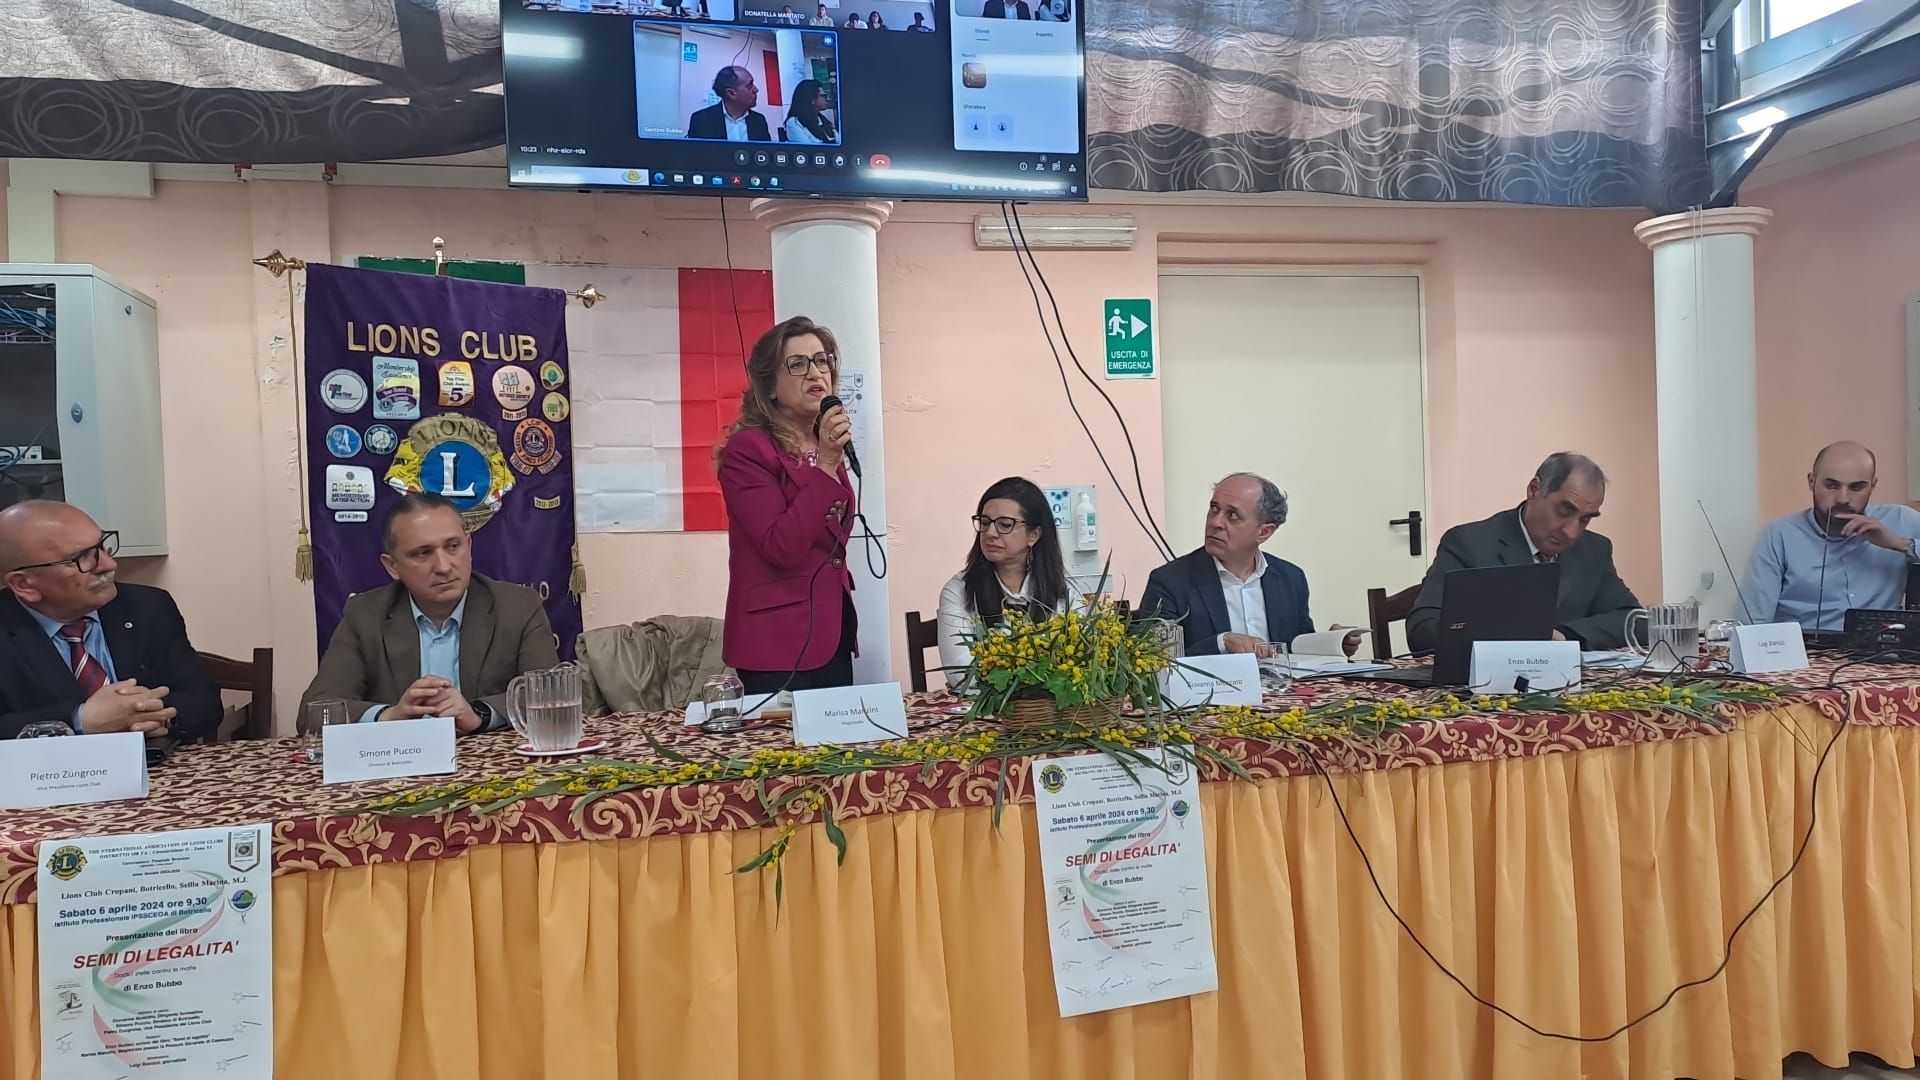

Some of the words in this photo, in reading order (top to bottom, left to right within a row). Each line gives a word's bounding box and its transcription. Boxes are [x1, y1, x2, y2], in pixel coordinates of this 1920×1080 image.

[346, 321, 440, 358] LIONS
[459, 329, 538, 362] CLUB
[1110, 350, 1138, 359] USCITA
[1140, 350, 1149, 358] DI
[376, 362, 417, 372] Membership
[1108, 361, 1152, 370] EMERGENZA
[450, 388, 464, 402] 5
[416, 420, 490, 447] LIONS
[440, 452, 476, 496] L
[824, 710, 849, 718] Marisa
[358, 750, 391, 758] Simone
[394, 746, 422, 756] Puccio
[30, 771, 60, 781] Pietro
[62, 768, 108, 779] Zungrone
[1052, 816, 1078, 826] Sabato
[1086, 812, 1107, 823] aprile
[1108, 810, 1125, 818] 2024
[1140, 806, 1156, 816] 9,30
[1086, 834, 1127, 844] Presentazione
[1065, 852, 1096, 868] SEMI
[1100, 852, 1112, 863] DI
[1116, 842, 1181, 861] LEGALITA'
[1124, 876, 1144, 884] Bubbo
[61, 892, 82, 900] Lions
[84, 890, 103, 898] Club
[104, 887, 138, 896] Cropani,
[140, 884, 178, 892] Botricello,
[201, 879, 230, 887] Marina,
[59, 908, 97, 919] Sabato
[98, 906, 106, 914] 6
[108, 903, 138, 915] aprile
[140, 900, 164, 911] 2024
[166, 900, 184, 909] ore
[186, 896, 208, 907] 9,30
[54, 918, 80, 928] Istituto
[81, 915, 130, 926] Professionale
[178, 907, 212, 917] Botricello
[106, 930, 164, 942] Presentazione
[165, 929, 178, 937] del
[72, 952, 118, 969] SEMI
[122, 950, 141, 964] DI
[146, 940, 240, 962] LEGALITA'
[124, 984, 132, 992] di
[134, 982, 154, 991] Enzo
[155, 979, 183, 989] Bubbo
